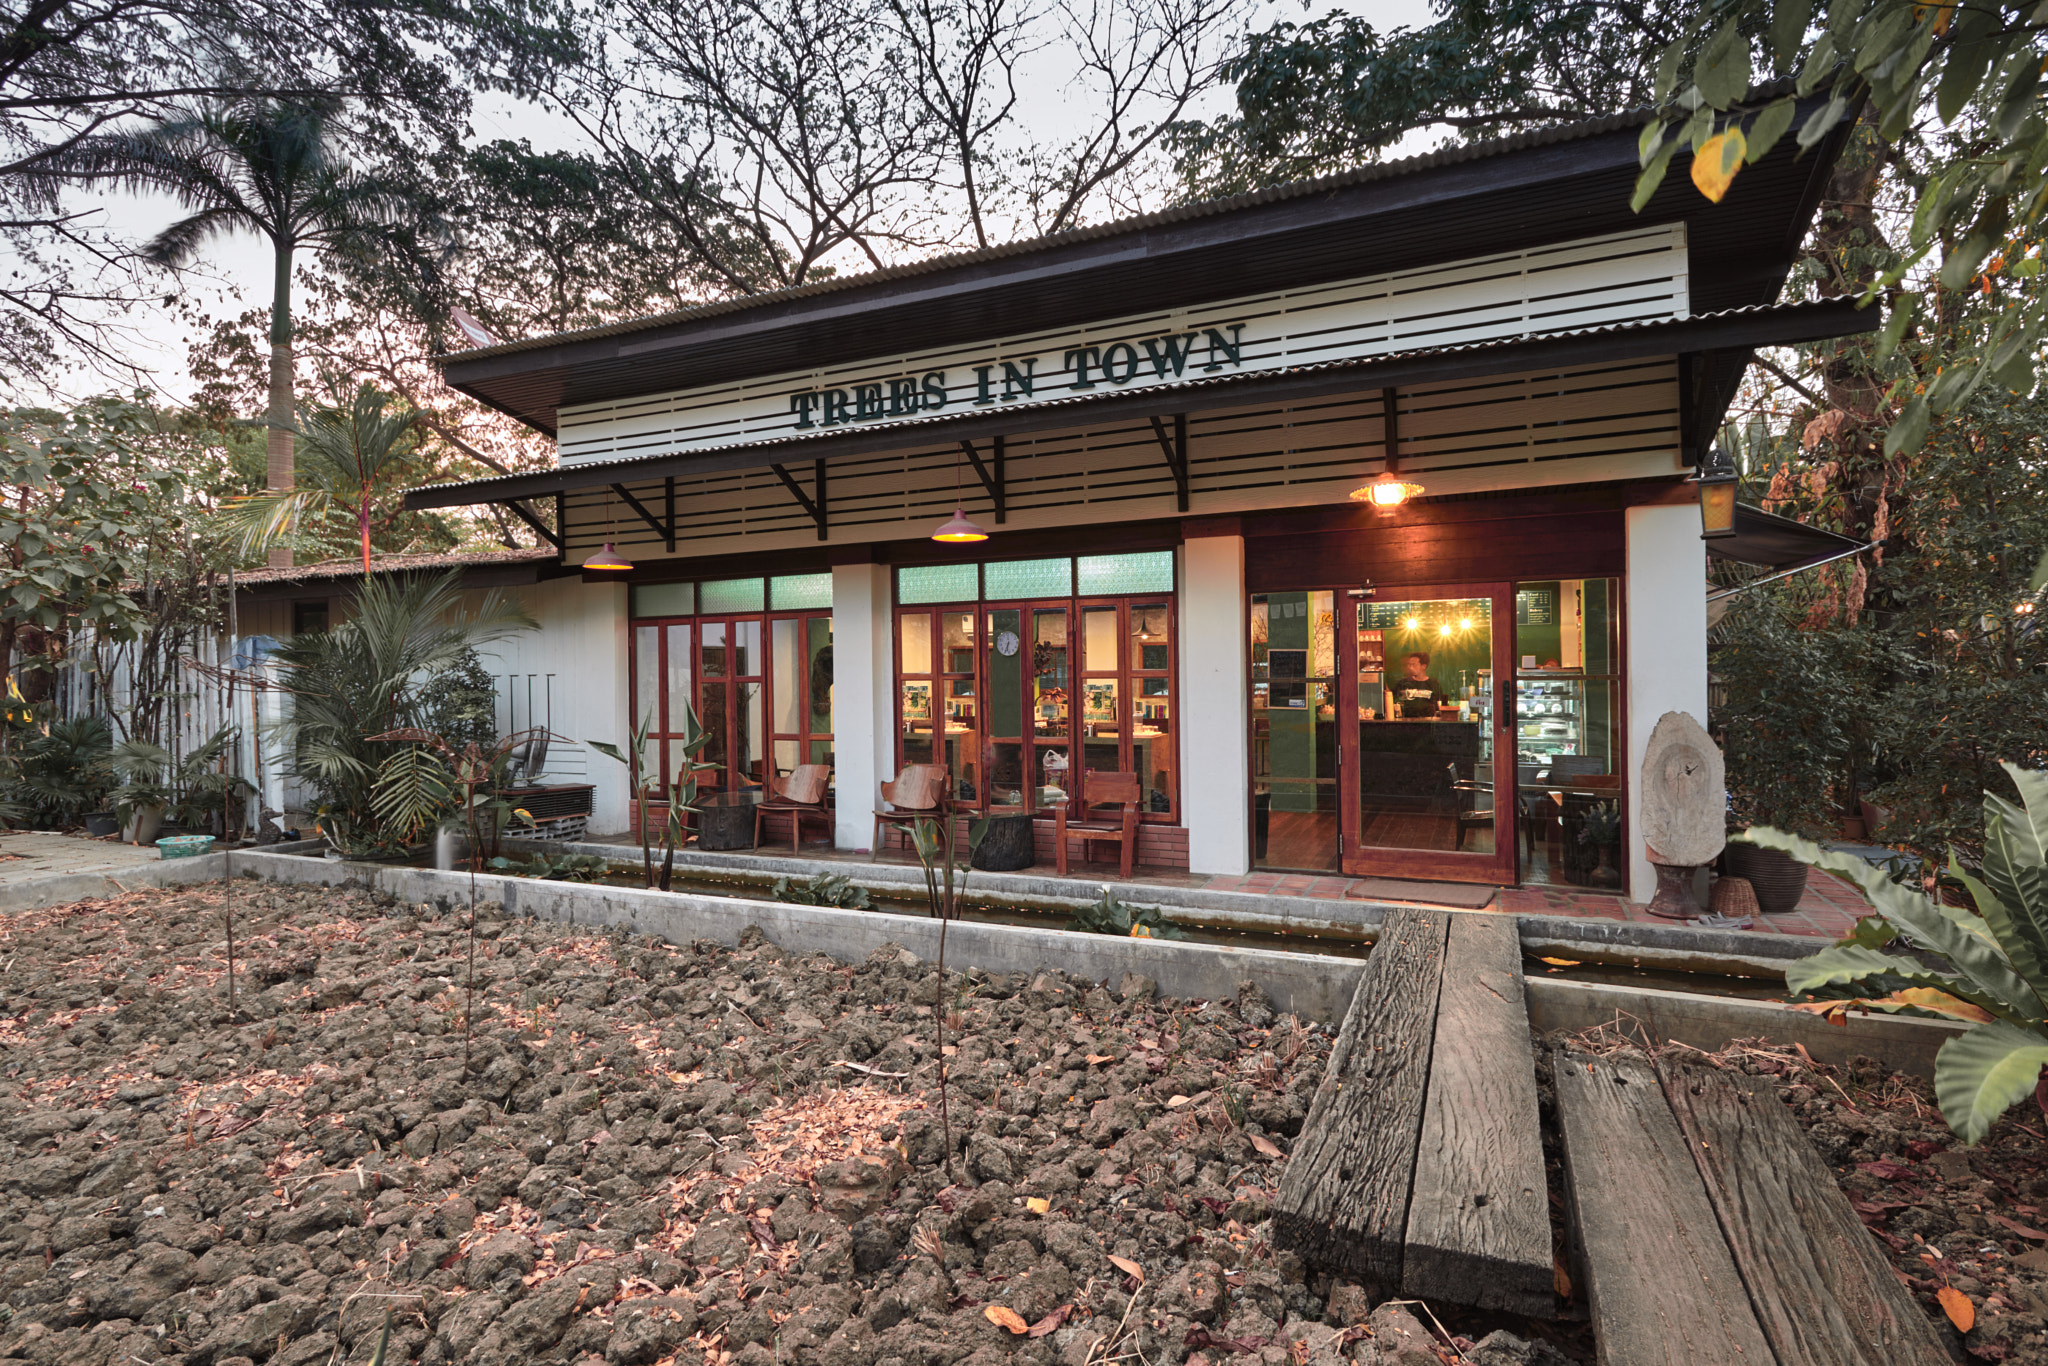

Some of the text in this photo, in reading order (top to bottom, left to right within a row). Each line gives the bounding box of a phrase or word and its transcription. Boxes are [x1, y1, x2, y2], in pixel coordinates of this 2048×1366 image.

[790, 322, 1247, 430] TREES IN TOWN
